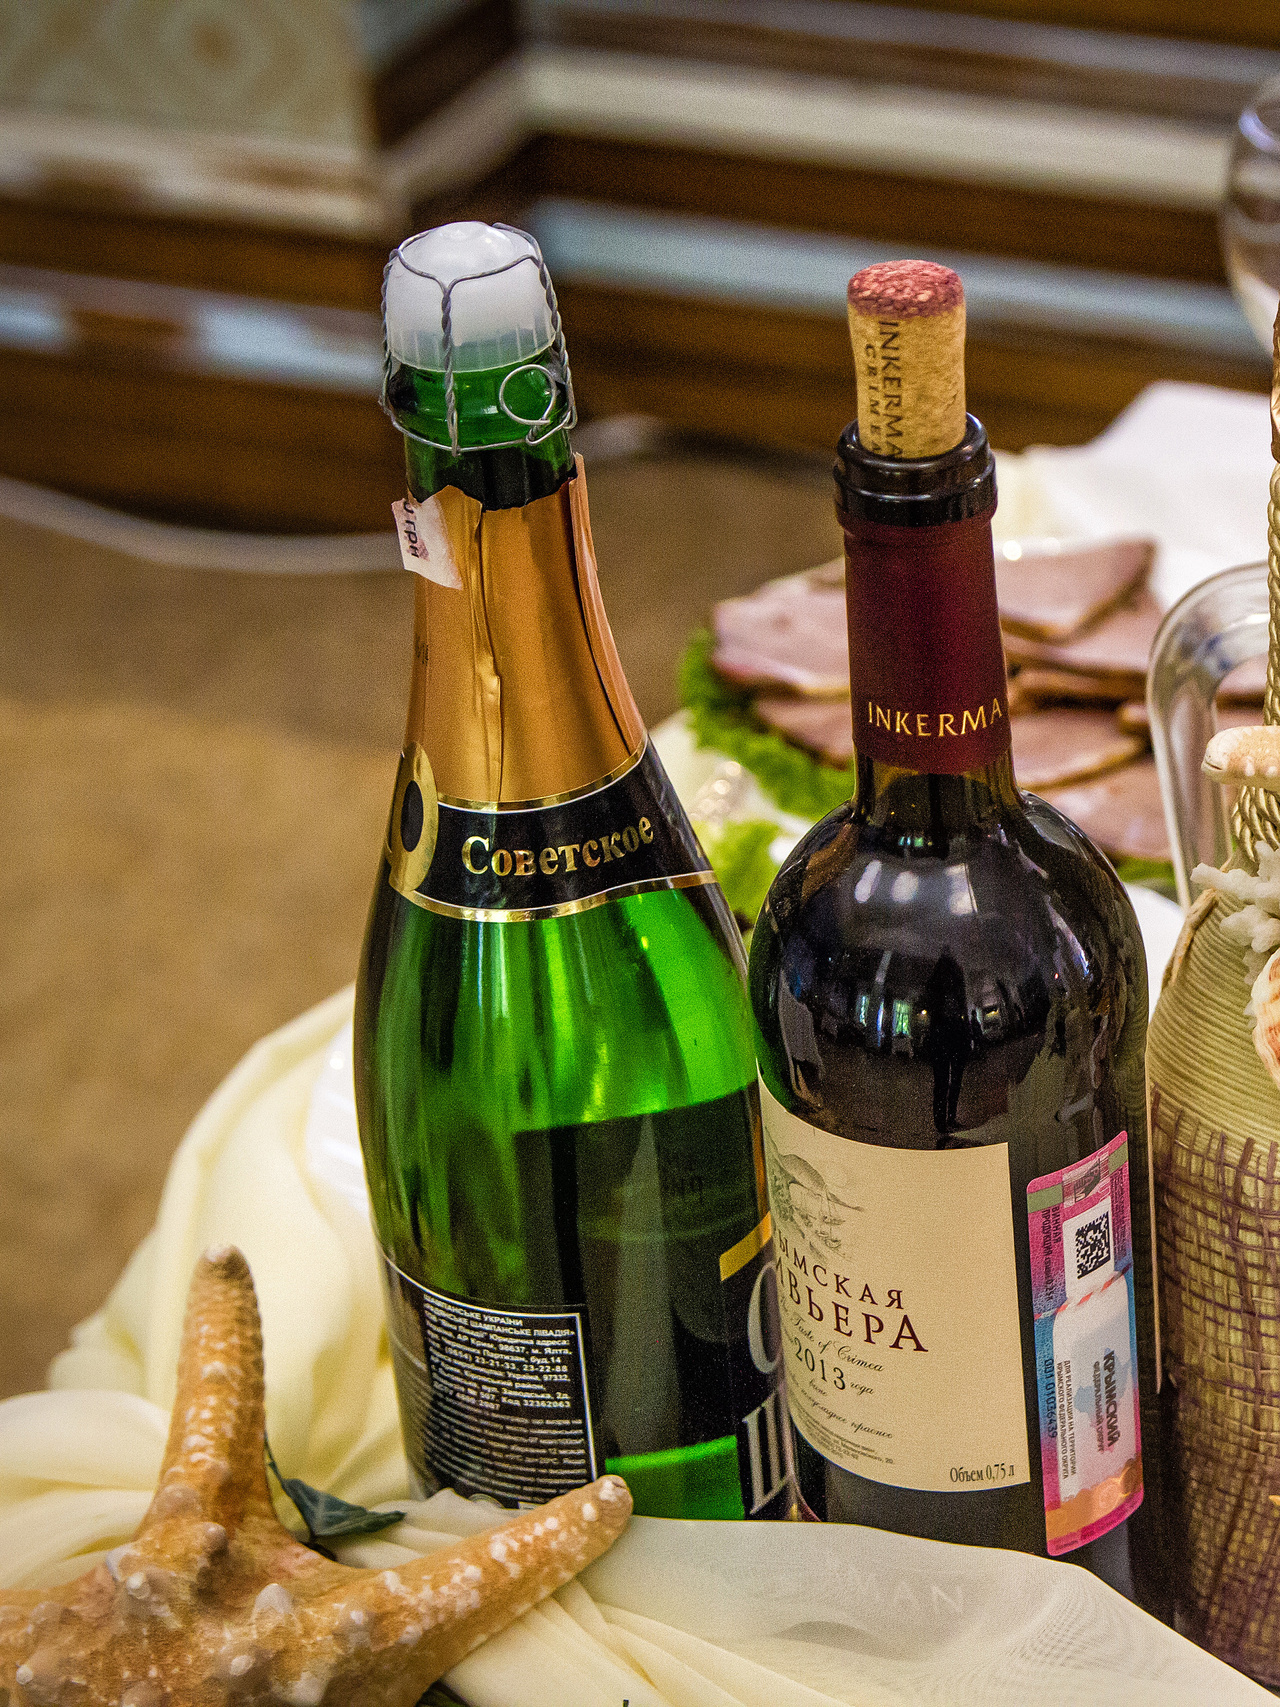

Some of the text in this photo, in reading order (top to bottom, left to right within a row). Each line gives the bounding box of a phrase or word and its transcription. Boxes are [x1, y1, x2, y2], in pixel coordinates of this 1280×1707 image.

[868, 697, 1003, 737] INKERMA
[461, 816, 655, 877] Советское
[1051, 1205, 1062, 1244] ВИННАЯ
[775, 1226, 904, 1310] ЫМСКАЯ
[794, 1337, 846, 1390] 2013
[833, 1341, 885, 1372] Crimea
[1103, 1349, 1121, 1448] КРЫМСКИЙ
[949, 1462, 1015, 1483] Объем 0,75 л
